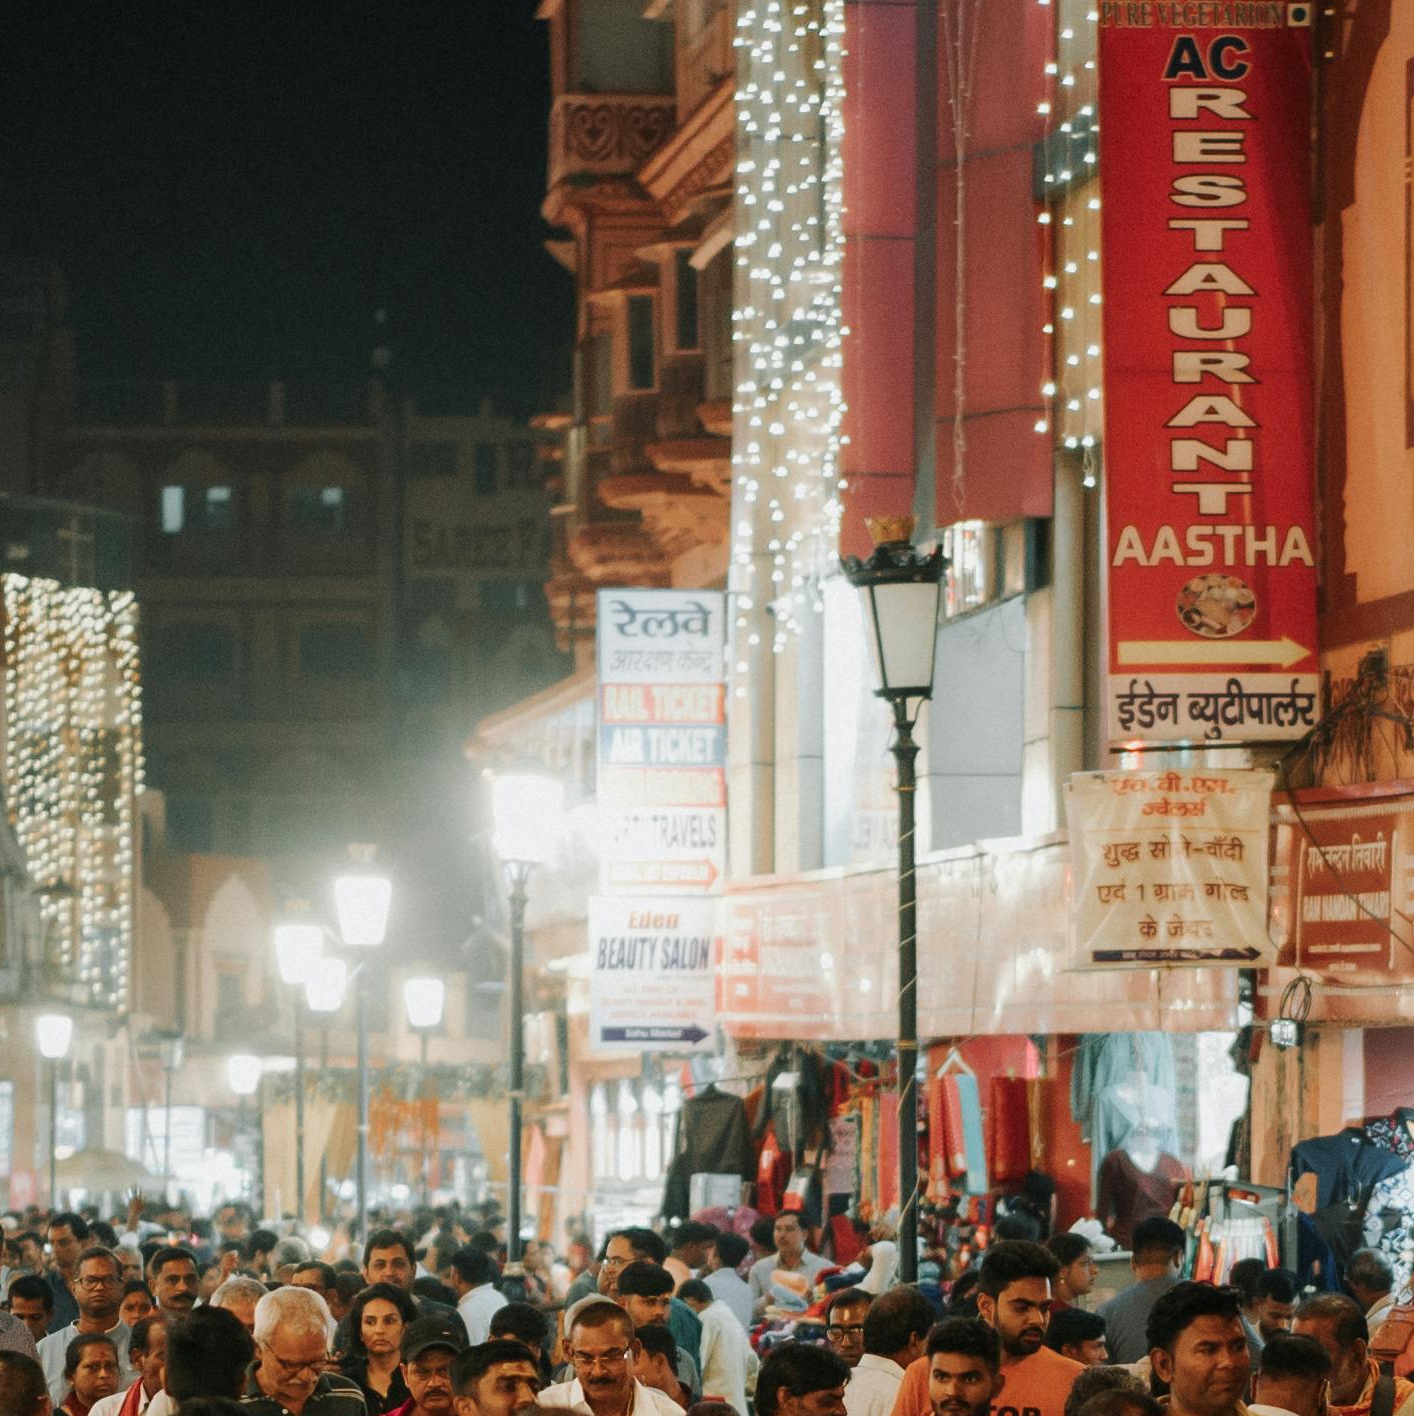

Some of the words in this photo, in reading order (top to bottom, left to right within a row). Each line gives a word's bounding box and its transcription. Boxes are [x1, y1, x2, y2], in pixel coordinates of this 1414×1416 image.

[1163, 34, 1251, 82] AC
[1162, 87, 1260, 516] RESTAURANT
[1112, 524, 1317, 568] AASTHA
[610, 600, 713, 638] रेलवे
[651, 686, 720, 721] TICKET
[610, 727, 645, 762] AIR
[647, 727, 719, 763] TICKET
[651, 814, 716, 848] TRAVELS
[597, 936, 658, 970] BEAUTY
[660, 936, 711, 970] SALON
